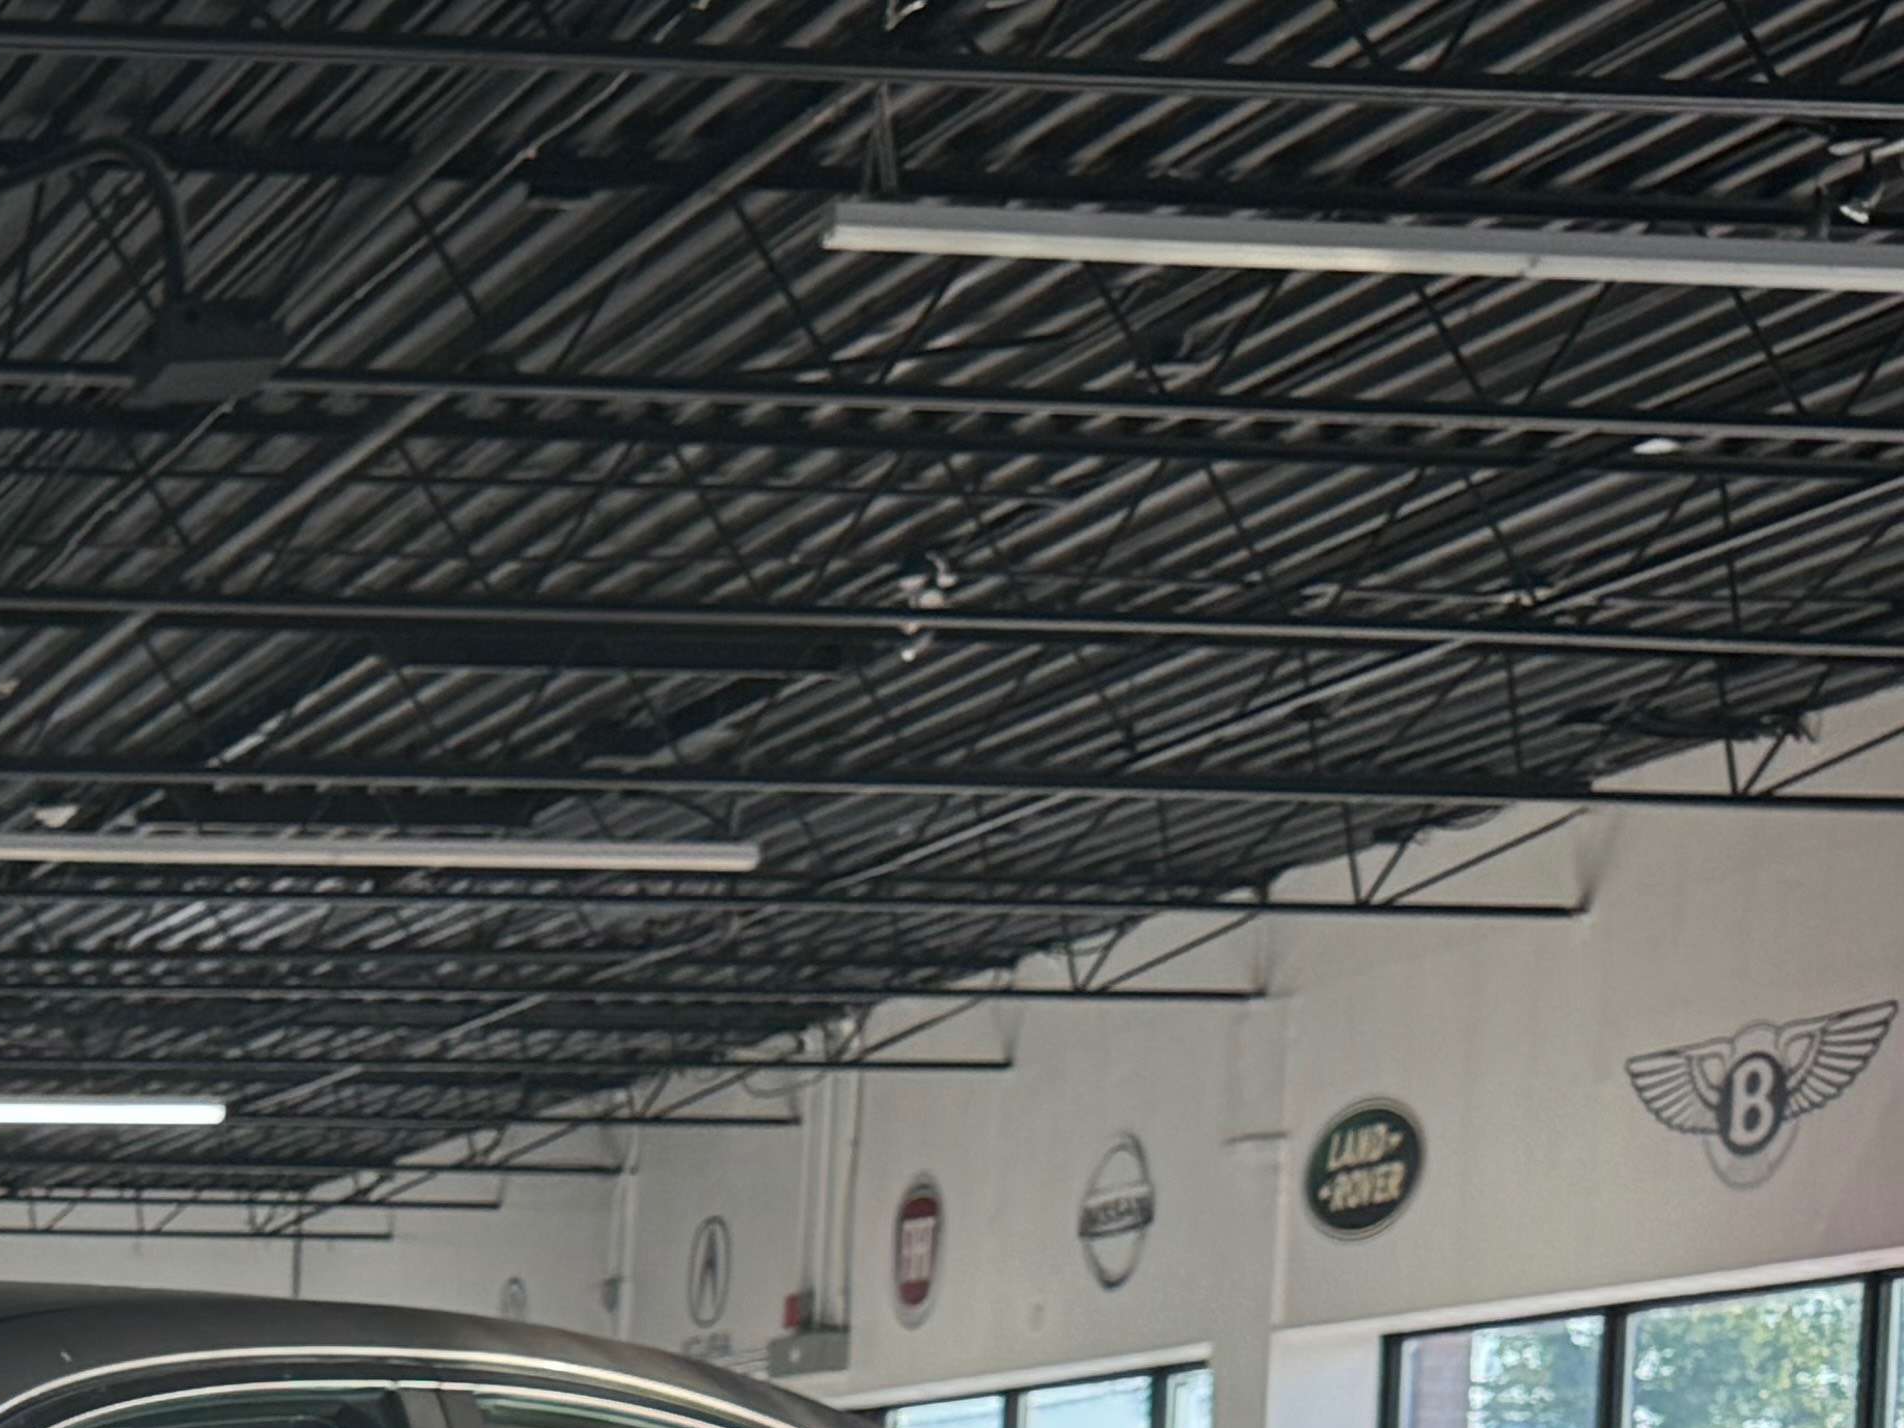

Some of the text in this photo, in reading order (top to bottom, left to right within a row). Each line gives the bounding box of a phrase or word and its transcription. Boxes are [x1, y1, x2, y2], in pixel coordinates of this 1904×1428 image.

[1729, 1056, 1776, 1146] B
[1326, 1122, 1390, 1171] LAND
[1328, 1160, 1406, 1213] ROVER
